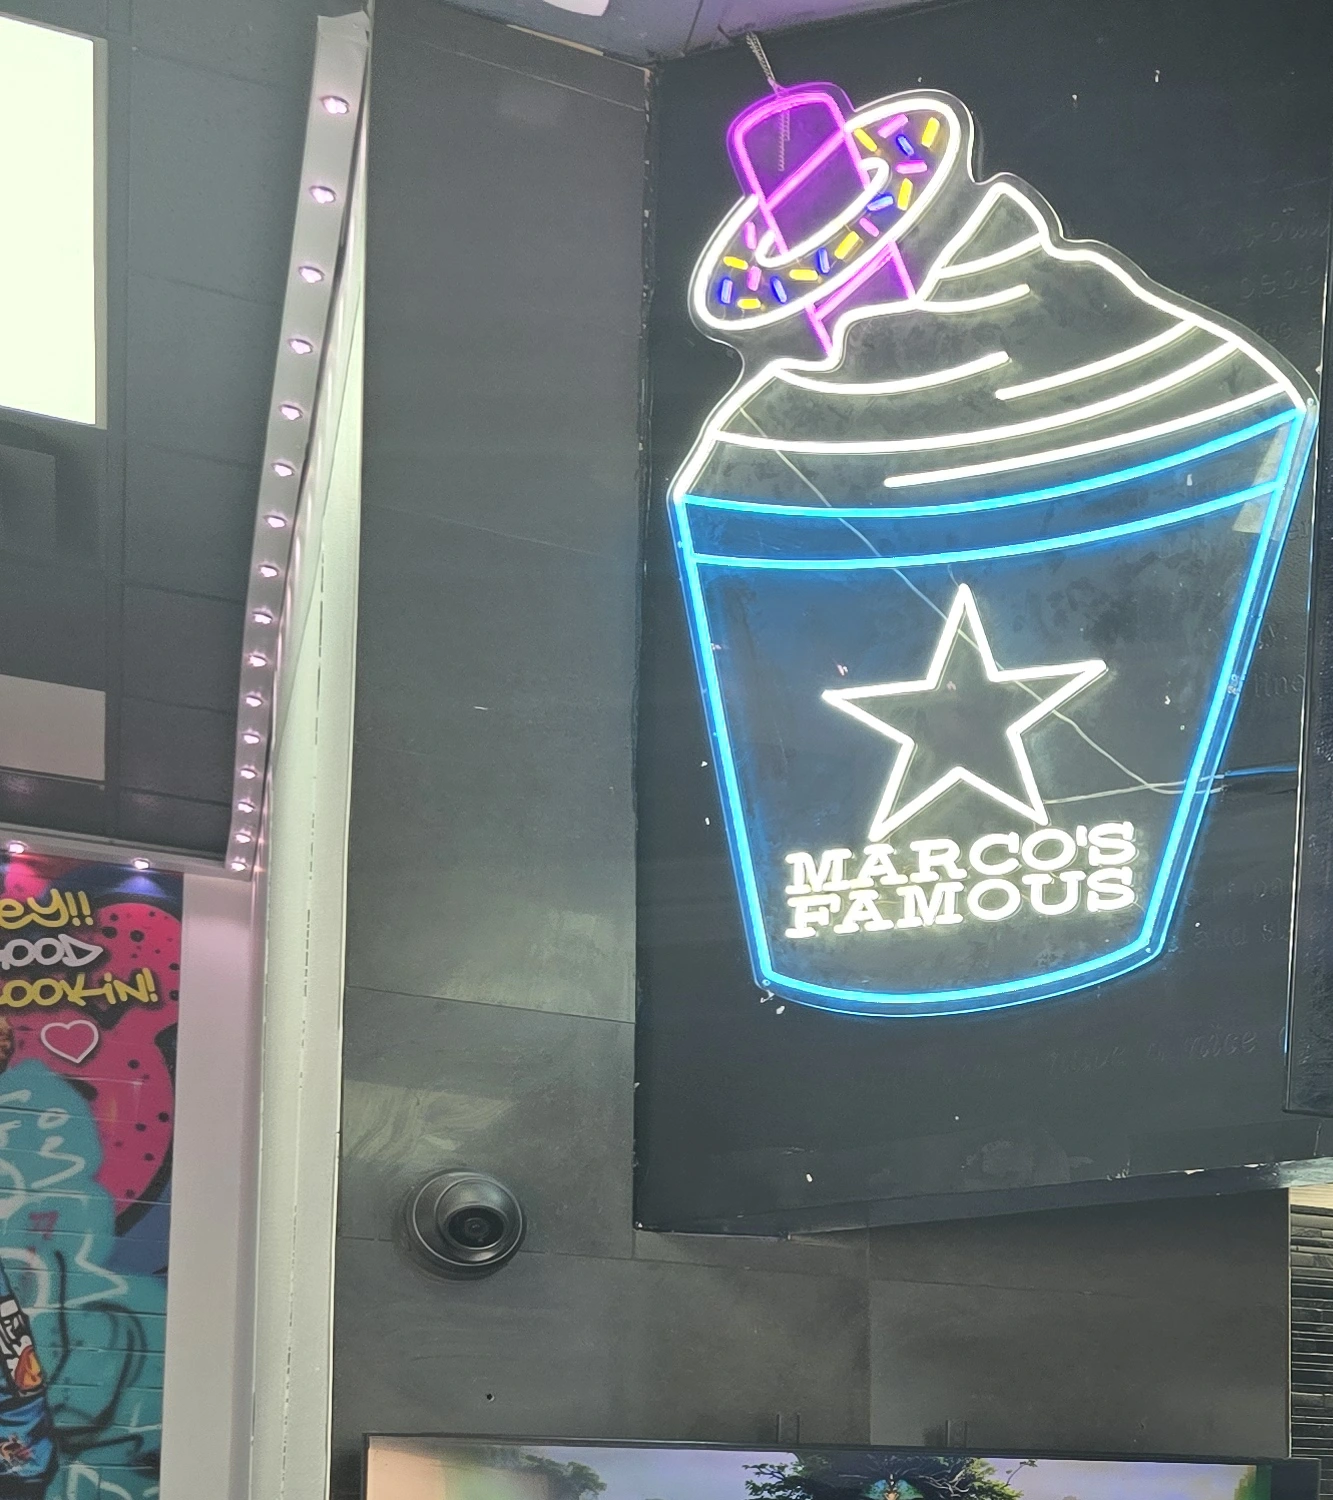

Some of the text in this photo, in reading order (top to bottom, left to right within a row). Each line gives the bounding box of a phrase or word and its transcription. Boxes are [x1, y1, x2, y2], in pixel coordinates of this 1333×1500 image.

[784, 821, 1137, 895] MARCO'S
[784, 866, 1137, 939] FAMOUS
[0, 933, 104, 970] OOD
